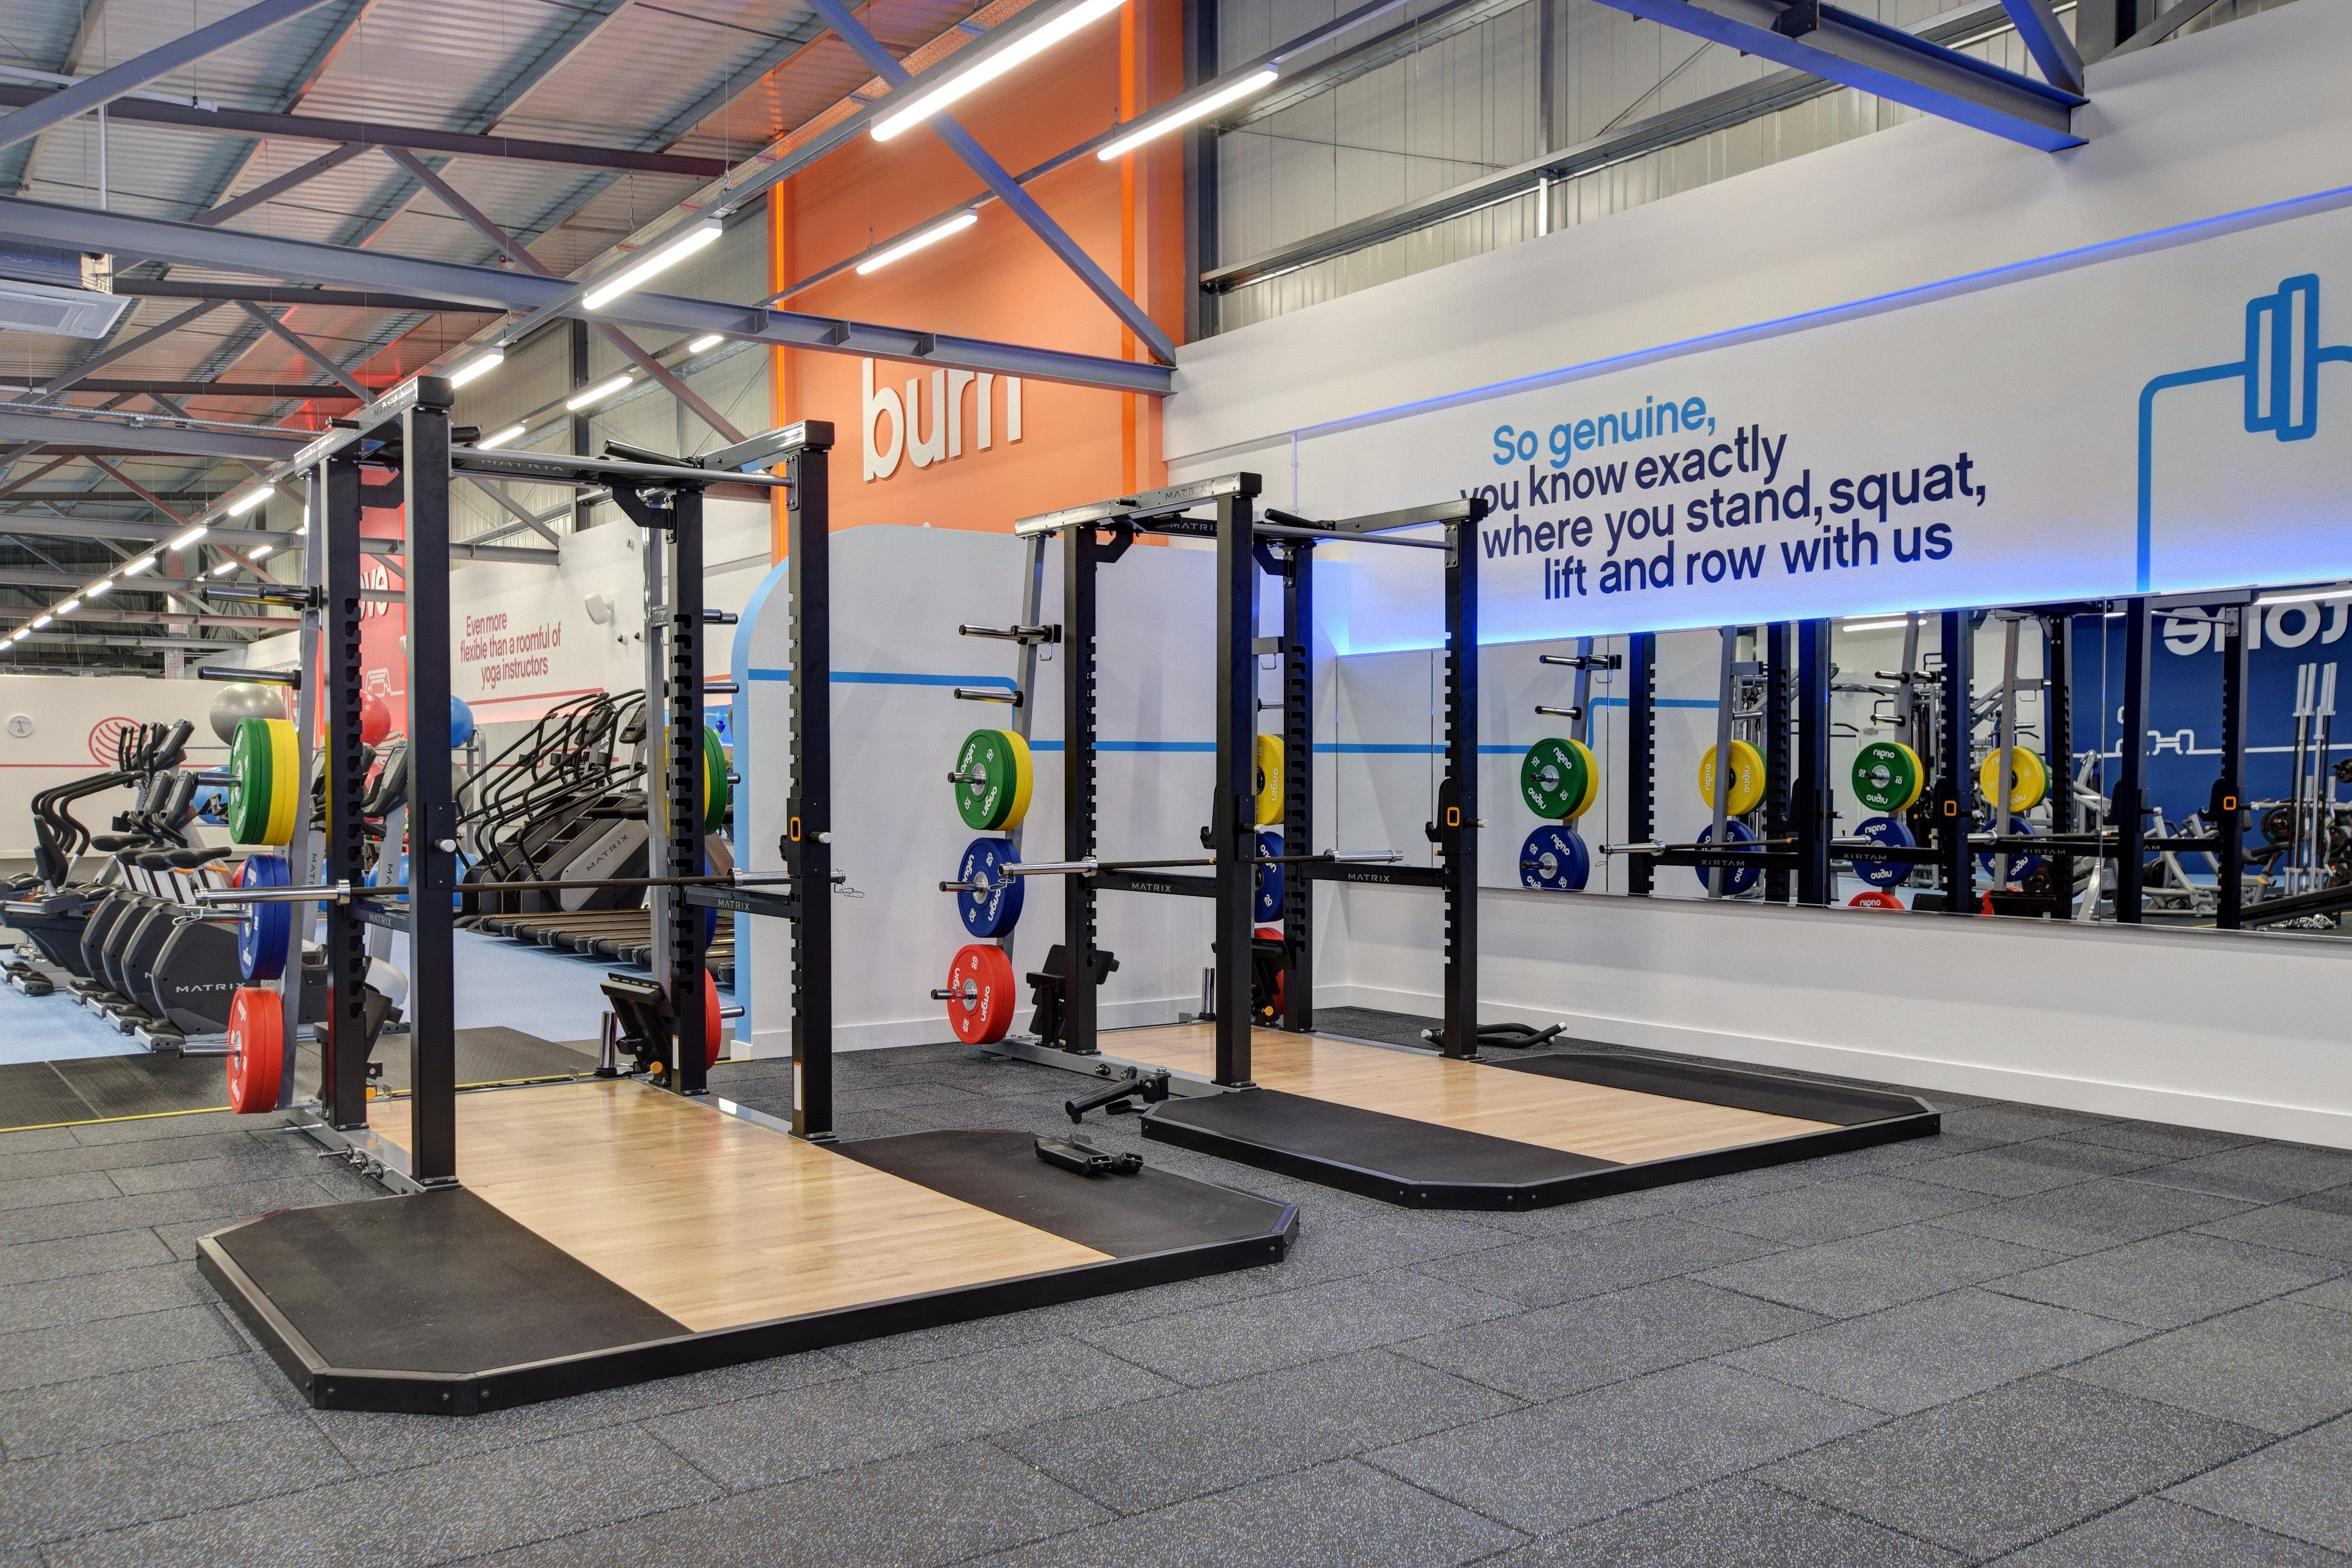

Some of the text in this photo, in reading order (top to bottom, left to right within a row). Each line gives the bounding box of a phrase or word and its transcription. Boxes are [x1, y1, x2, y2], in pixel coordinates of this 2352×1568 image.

[862, 358, 1021, 481] burn
[1493, 395, 1716, 469] So genuine,
[1530, 461, 1628, 507] know
[1635, 424, 1788, 490] exactly
[1482, 452, 1986, 559] where you stand, squat,
[1545, 518, 1953, 600] lift and row with us
[466, 612, 507, 637] Even more
[460, 621, 561, 663] flexible than a roomful of
[481, 655, 548, 691] yoga instructors
[961, 743, 976, 773] origin
[987, 748, 994, 762] 10
[982, 786, 997, 816] origin
[586, 834, 629, 871] MATRIX
[986, 852, 993, 867] 20
[1132, 882, 1171, 892] MATRIX
[1348, 873, 1389, 882] MATRIX
[718, 899, 749, 911] MATRIX
[988, 889, 1001, 921] origin
[1264, 894, 1272, 907] 20
[176, 982, 246, 993] MATRIX
[981, 986, 990, 1022] origin
